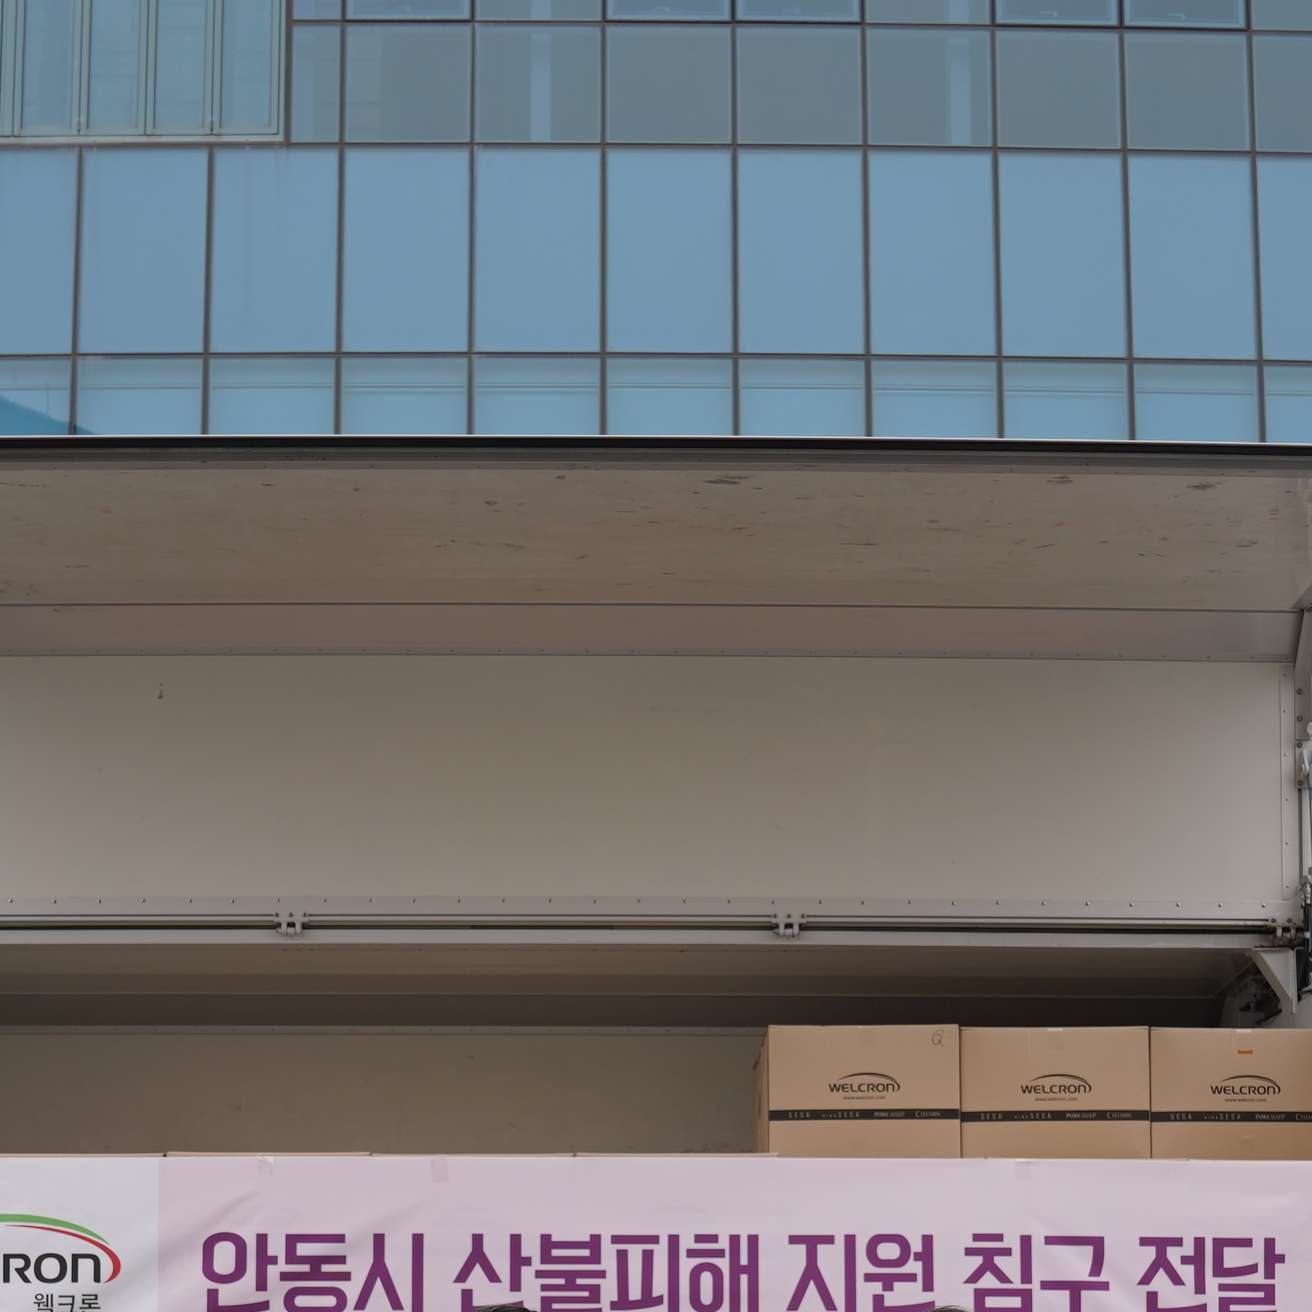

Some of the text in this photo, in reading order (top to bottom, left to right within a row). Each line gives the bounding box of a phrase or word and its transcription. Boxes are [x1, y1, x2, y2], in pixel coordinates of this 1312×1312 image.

[829, 1083, 895, 1093] WELCRON
[1021, 1084, 1087, 1094] WELCRON
[1210, 1085, 1276, 1096] WELCRON
